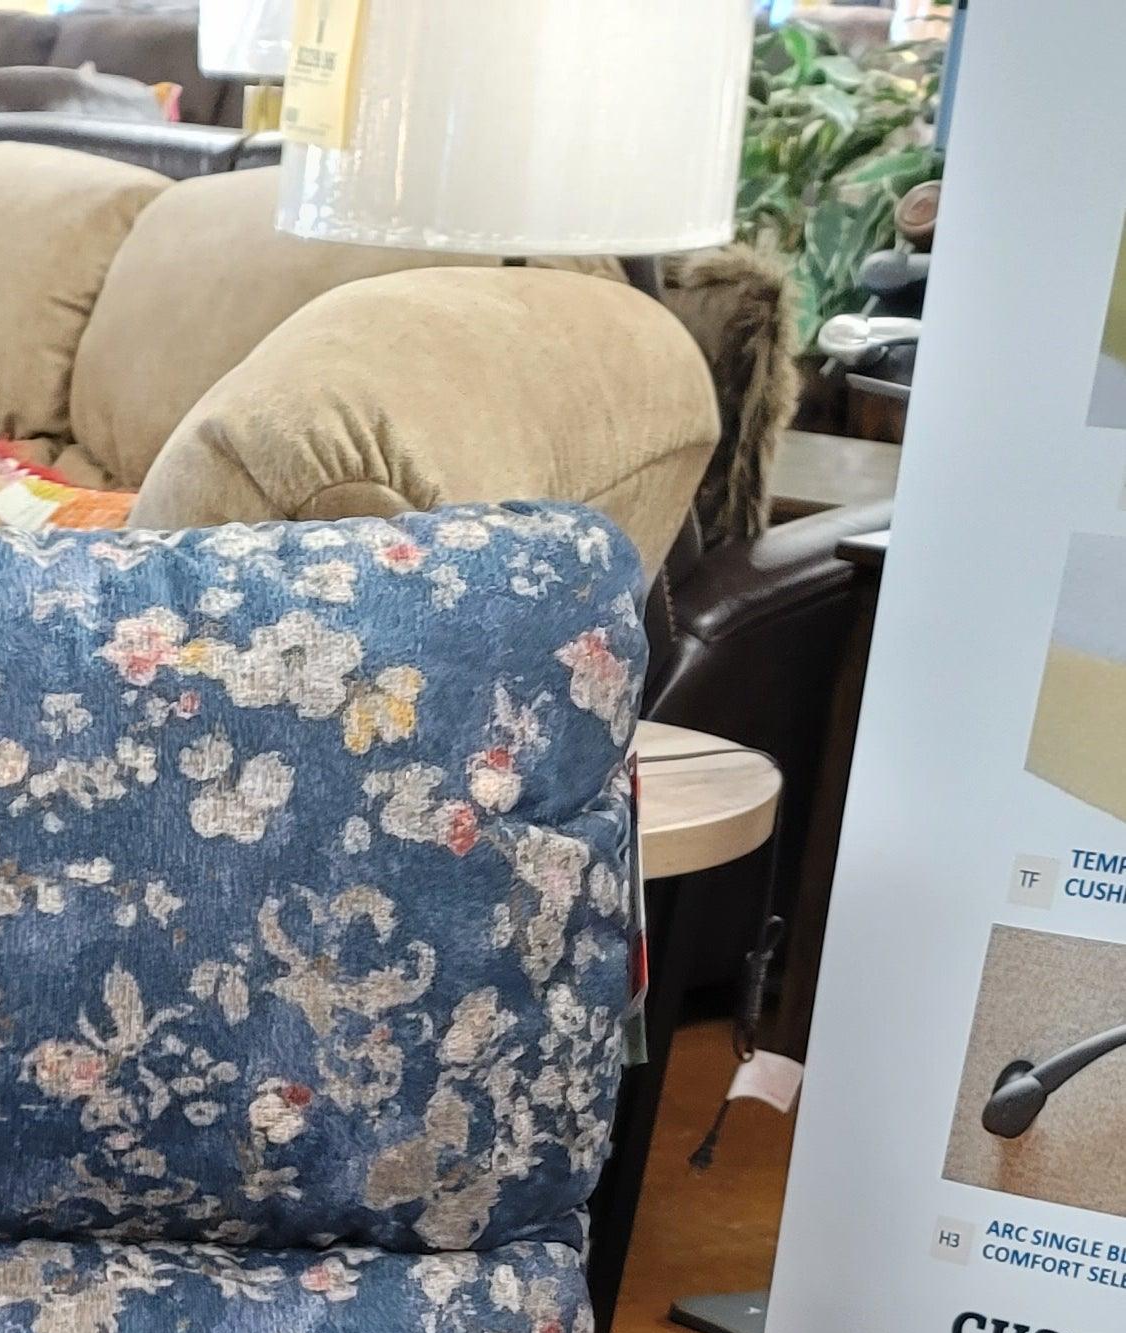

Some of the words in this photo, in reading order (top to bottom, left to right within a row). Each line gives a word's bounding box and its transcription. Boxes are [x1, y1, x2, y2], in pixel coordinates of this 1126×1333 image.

[1019, 868, 1042, 889] TF
[938, 1229, 961, 1248] H3
[985, 1219, 1029, 1243] ARC
[1030, 1228, 1103, 1259] SINGLE
[982, 1243, 1085, 1279] COMFORT
